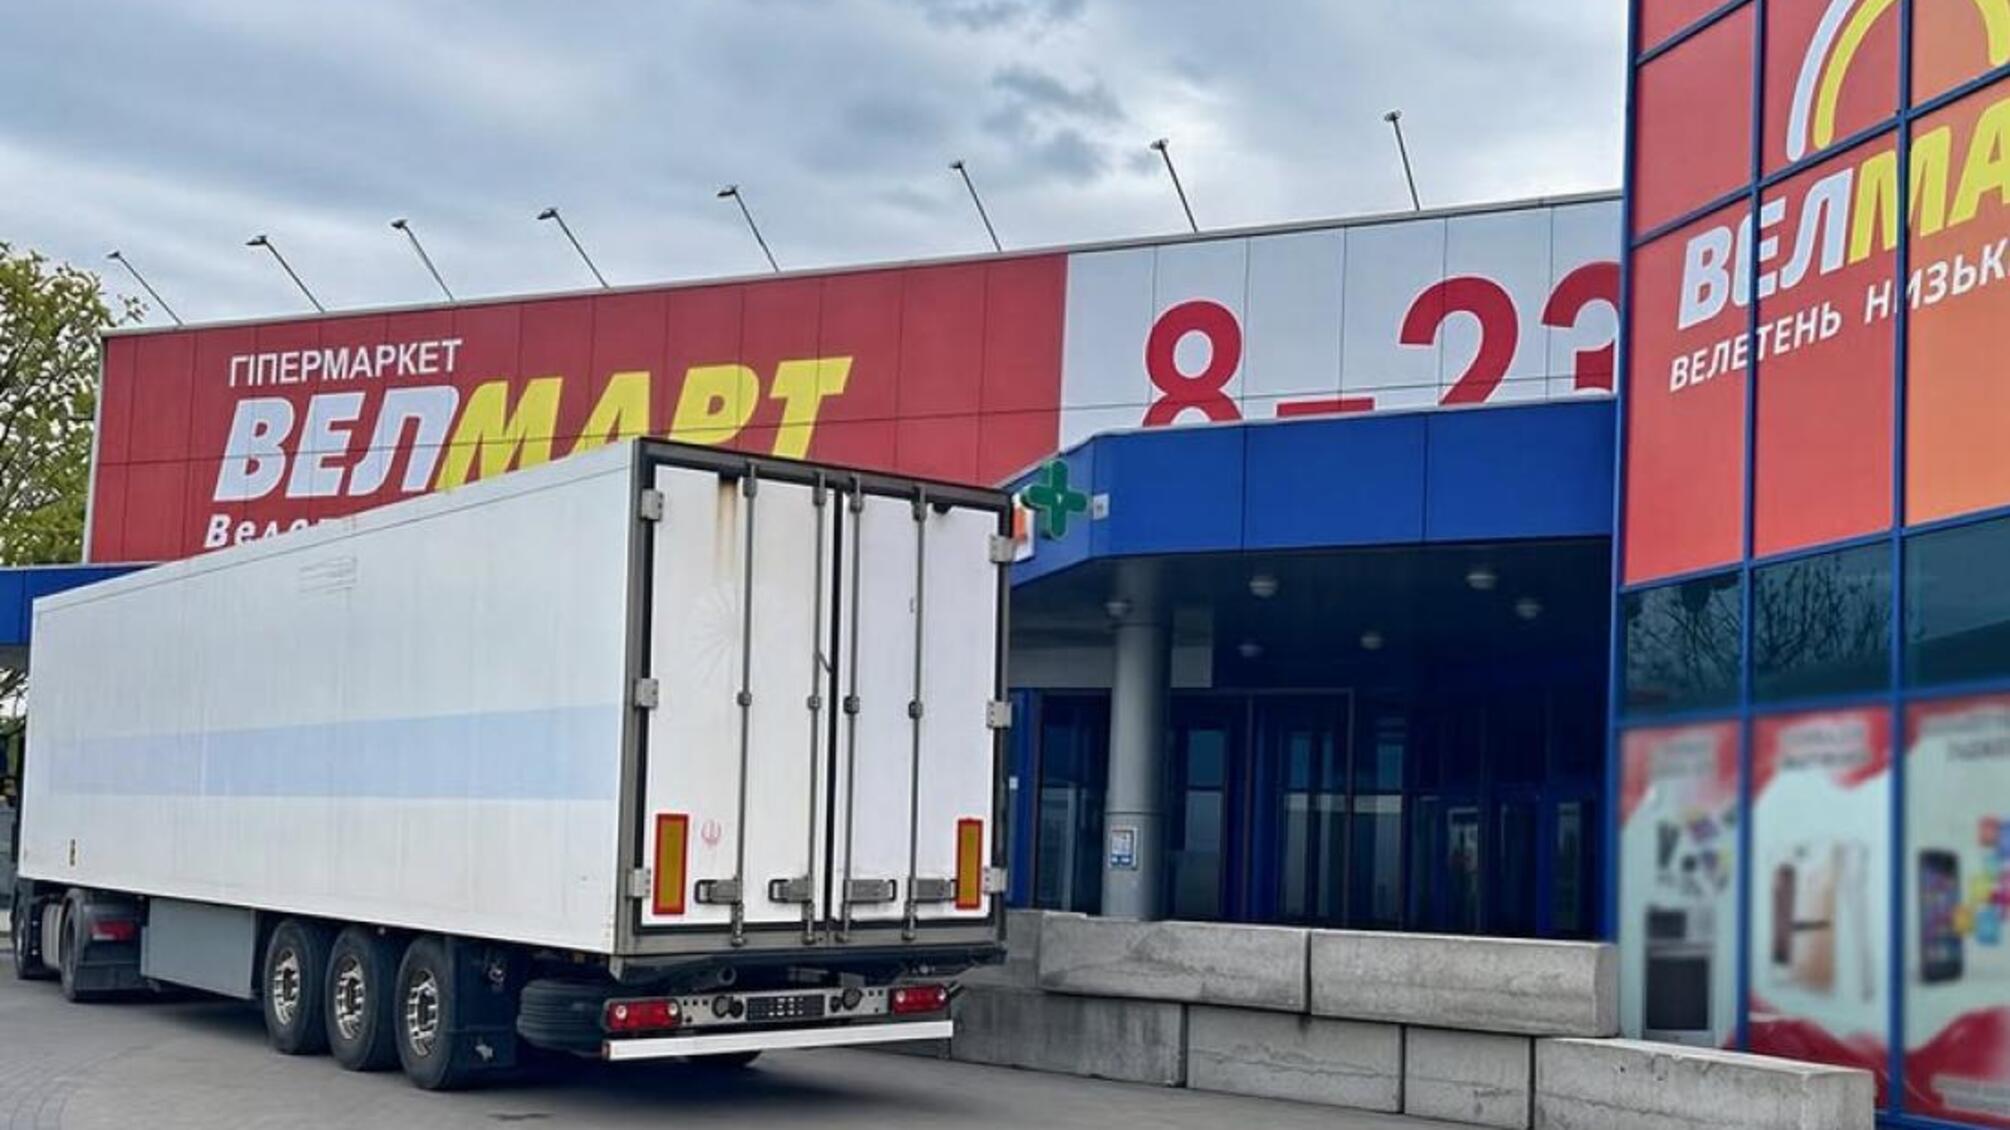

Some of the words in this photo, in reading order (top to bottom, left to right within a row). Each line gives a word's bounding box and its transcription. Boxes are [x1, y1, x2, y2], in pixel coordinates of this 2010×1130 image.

[229, 338, 463, 388] ГІПЕРМАРКЕТ
[1143, 300, 1243, 427] 8
[1669, 301, 1843, 392] ВЕЛЕТЕНЬ
[1864, 238, 2010, 324] НИЗЬК
[212, 356, 855, 502] ВЕЛМАРТ
